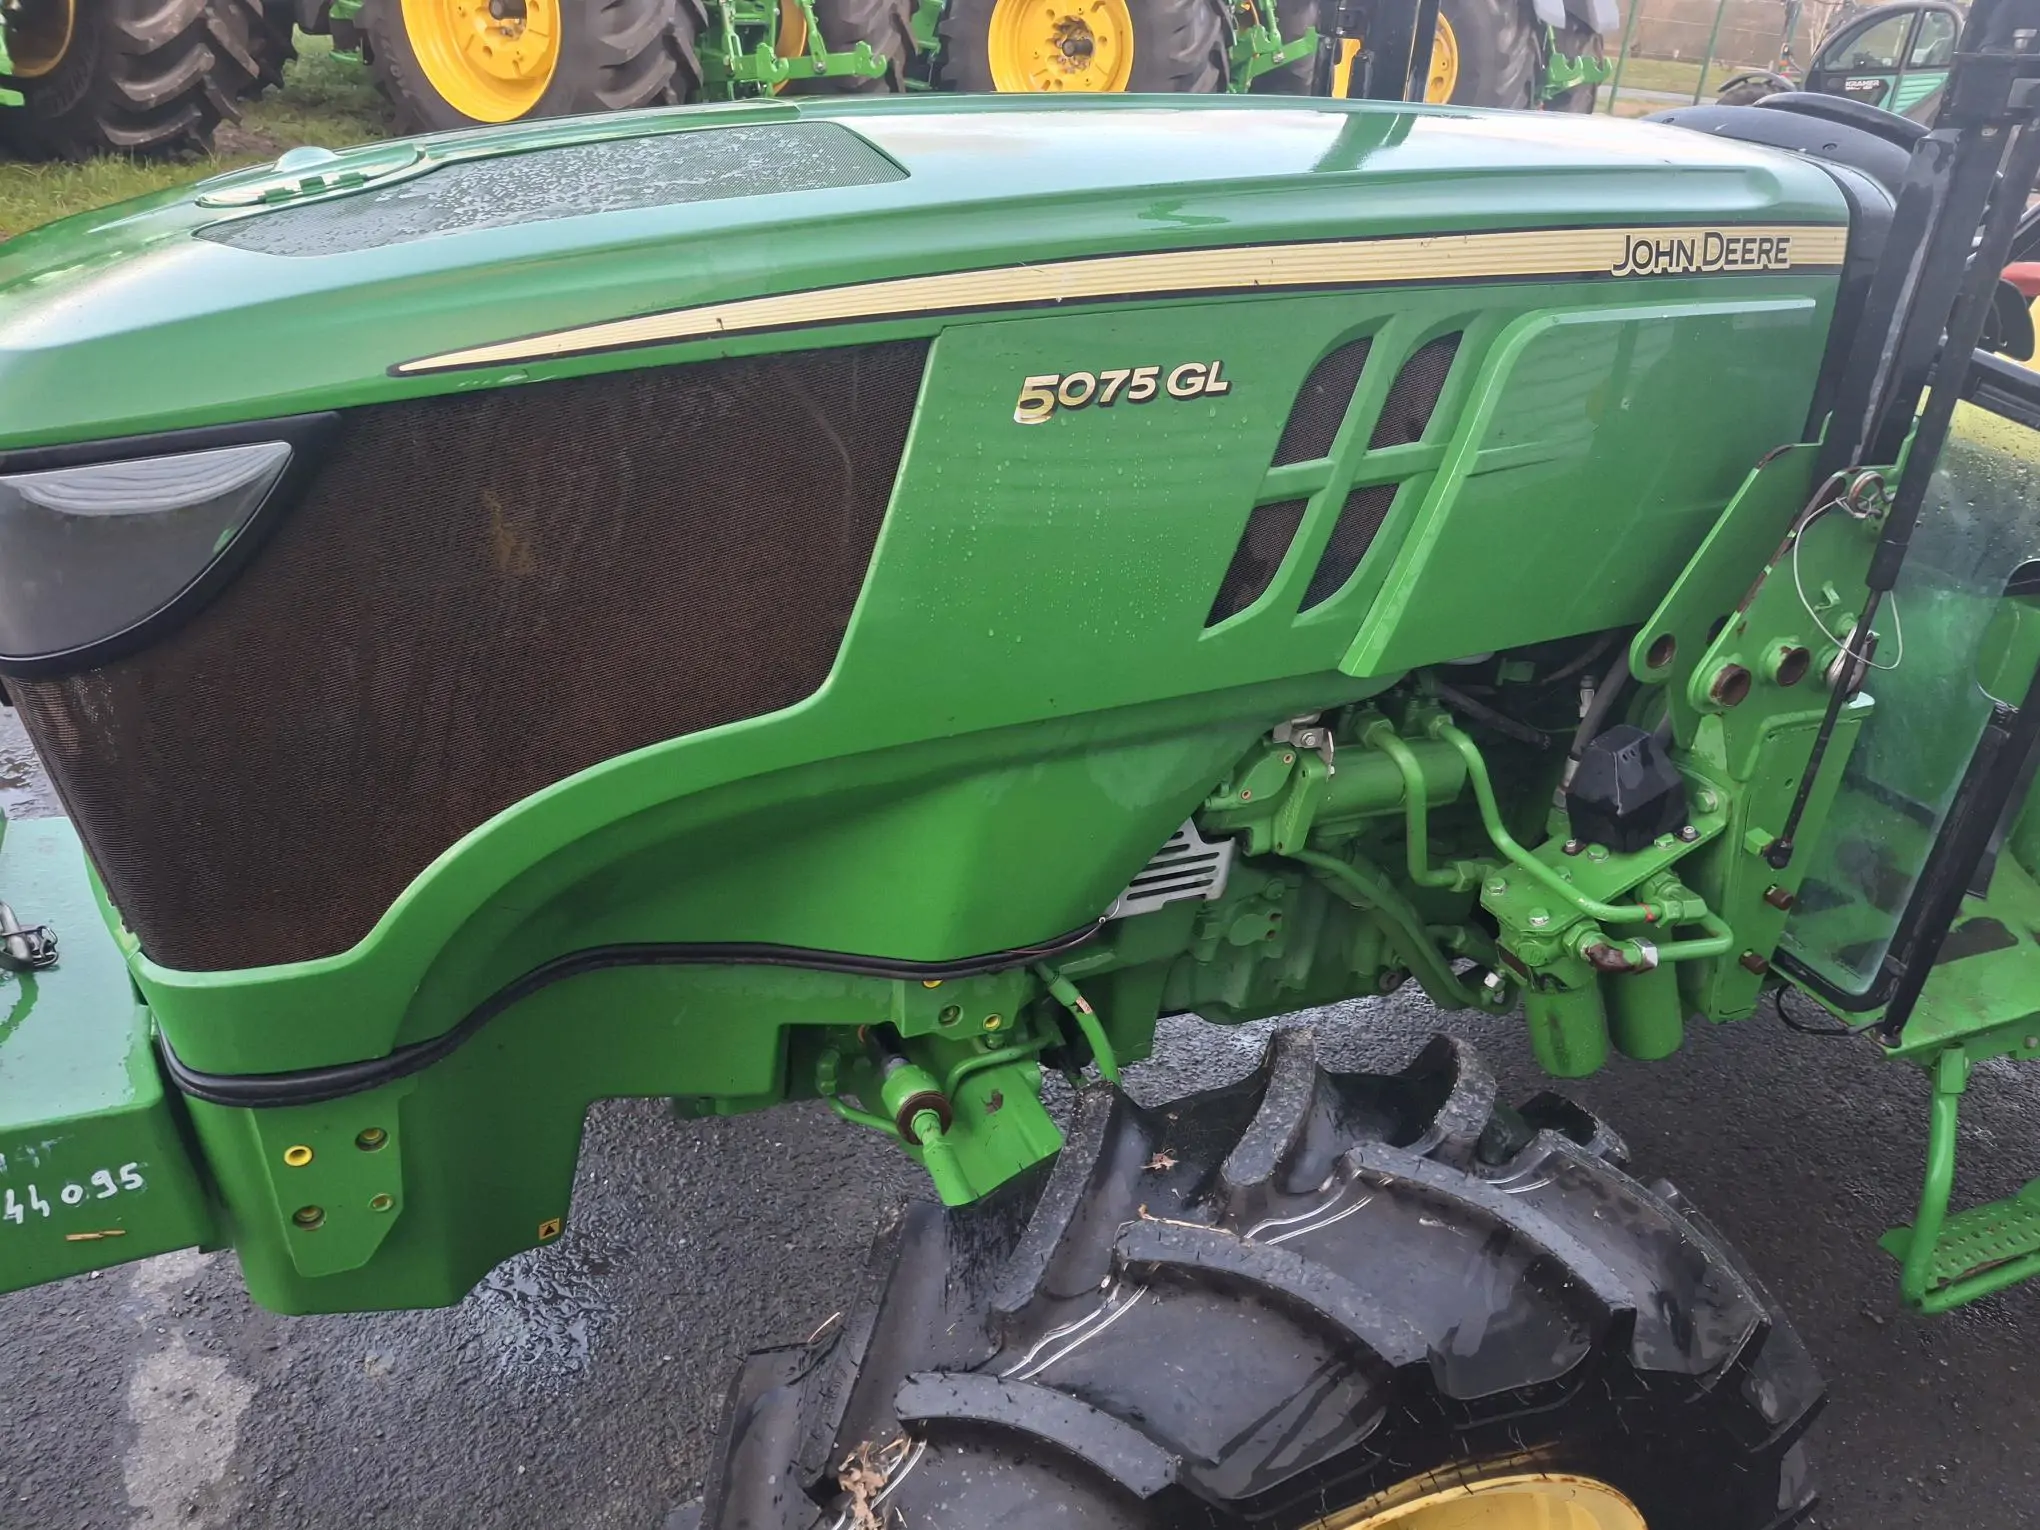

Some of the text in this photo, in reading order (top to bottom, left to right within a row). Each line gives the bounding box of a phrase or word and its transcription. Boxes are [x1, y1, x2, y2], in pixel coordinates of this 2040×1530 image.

[1612, 231, 1792, 276] JOHN DEERE
[1014, 360, 1232, 425] 5075 GL
